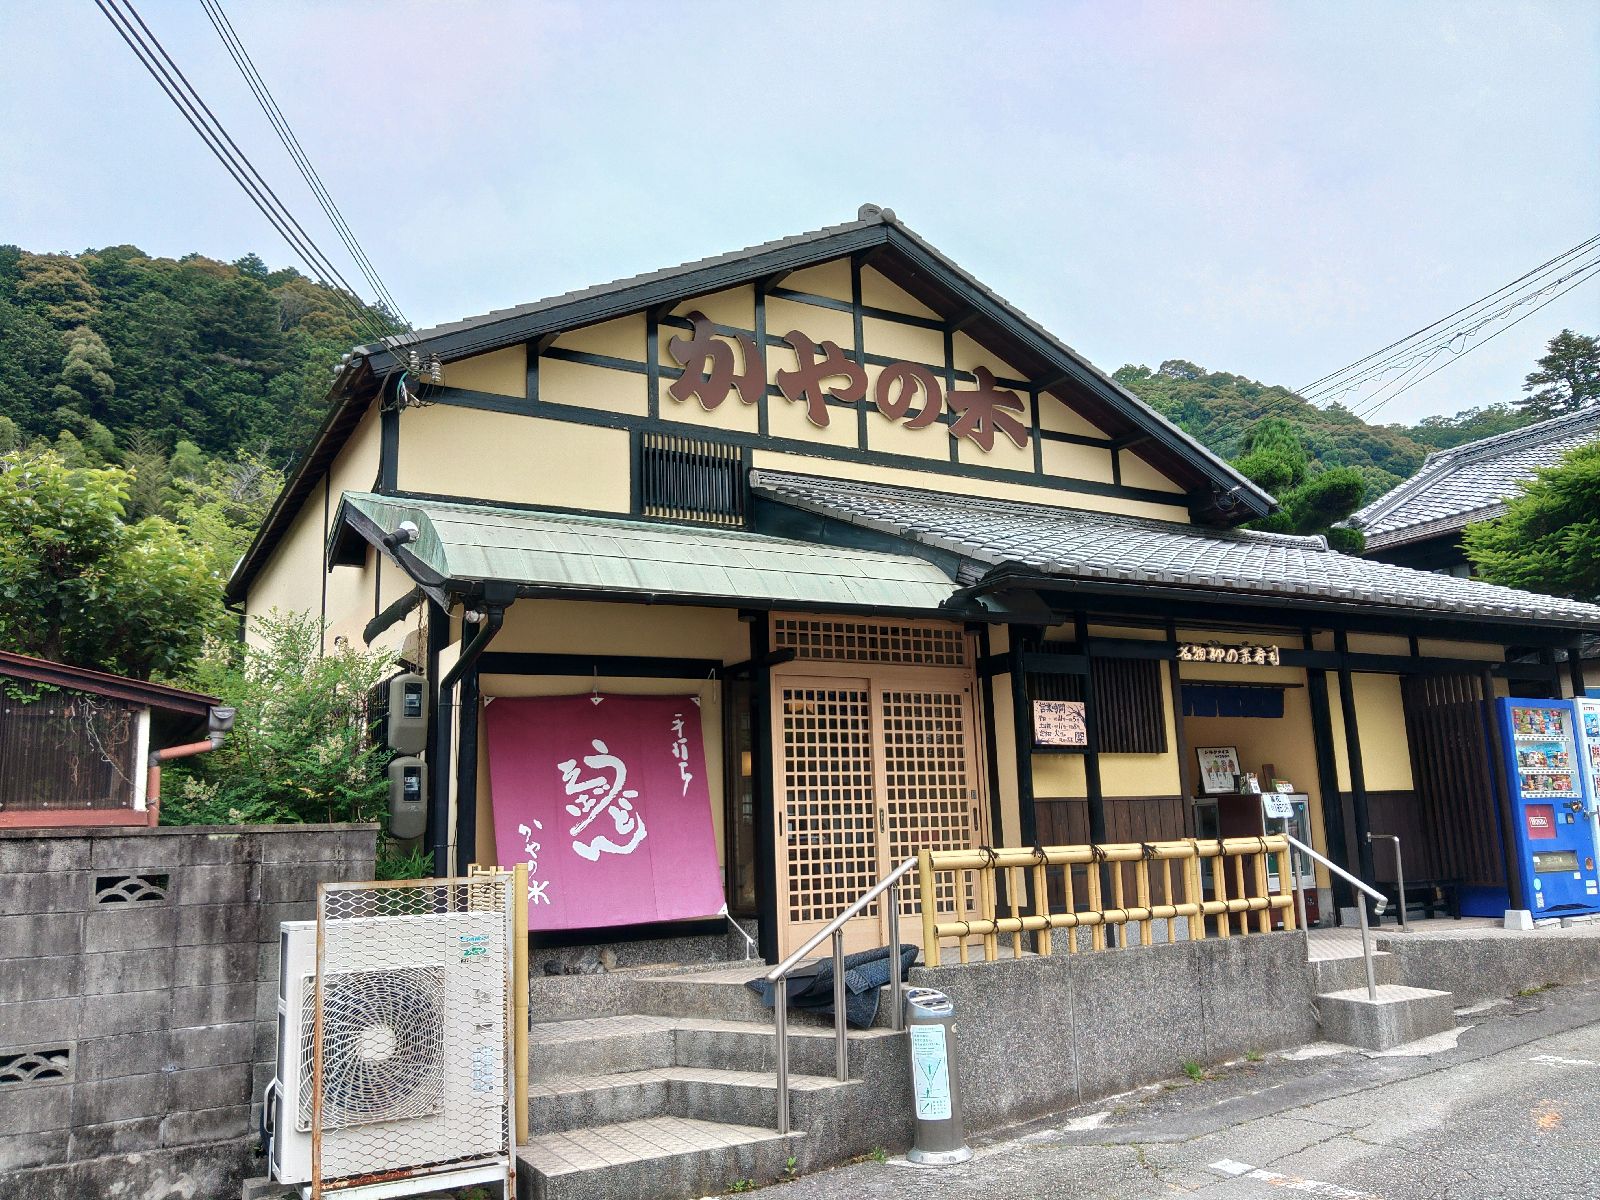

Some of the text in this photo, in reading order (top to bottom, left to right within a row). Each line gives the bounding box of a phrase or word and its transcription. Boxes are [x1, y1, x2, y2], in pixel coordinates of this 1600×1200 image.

[667, 310, 1029, 453] かやの木
[671, 713, 692, 797] 手打ち
[518, 819, 551, 905] かやの木
